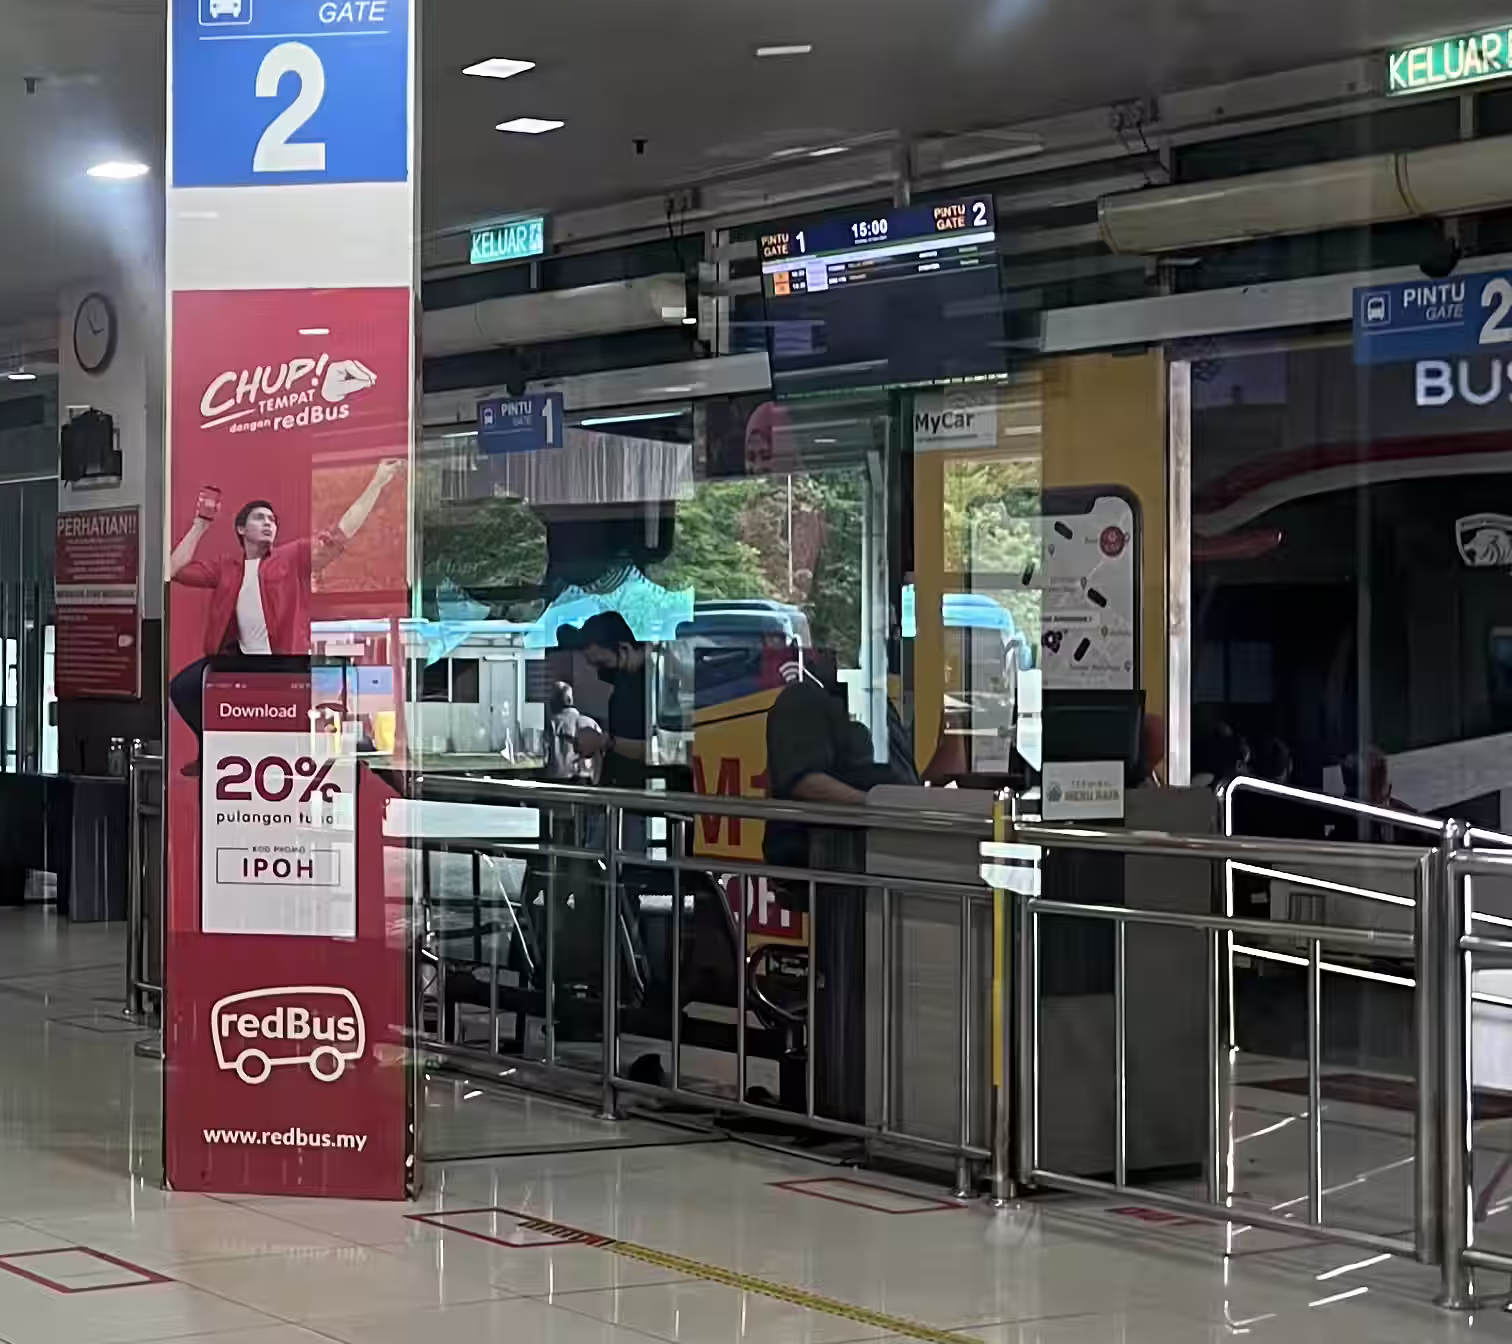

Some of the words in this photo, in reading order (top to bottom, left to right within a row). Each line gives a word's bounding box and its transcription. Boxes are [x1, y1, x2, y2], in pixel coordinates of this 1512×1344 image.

[319, 0, 387, 24] GATE
[1389, 33, 1502, 90] KELUAR
[252, 41, 326, 172] 2
[934, 204, 966, 219] PINTU
[972, 202, 987, 226] 2
[936, 216, 966, 231] GATE
[472, 225, 528, 257] KELUAR
[761, 233, 790, 247] PINTU
[795, 231, 806, 253] 1
[763, 243, 789, 257] GATE
[1403, 283, 1465, 308] PINTU
[1478, 278, 1512, 344] 2
[1426, 304, 1464, 321] GATE
[200, 353, 329, 418] CHUP!
[1415, 359, 1512, 406] BU
[258, 388, 316, 414] TEMPAT
[273, 404, 350, 432] redBus
[501, 400, 532, 416] PINTU
[542, 398, 553, 443] 1
[914, 412, 975, 434] MyCar
[57, 515, 137, 537] PERHATIAN!!
[219, 702, 298, 719] Download
[216, 755, 343, 803] 20%
[216, 809, 292, 826] pulangan
[243, 857, 313, 878] IPOH
[221, 1007, 356, 1041] redBus
[203, 1127, 367, 1152] www.redbus.my
